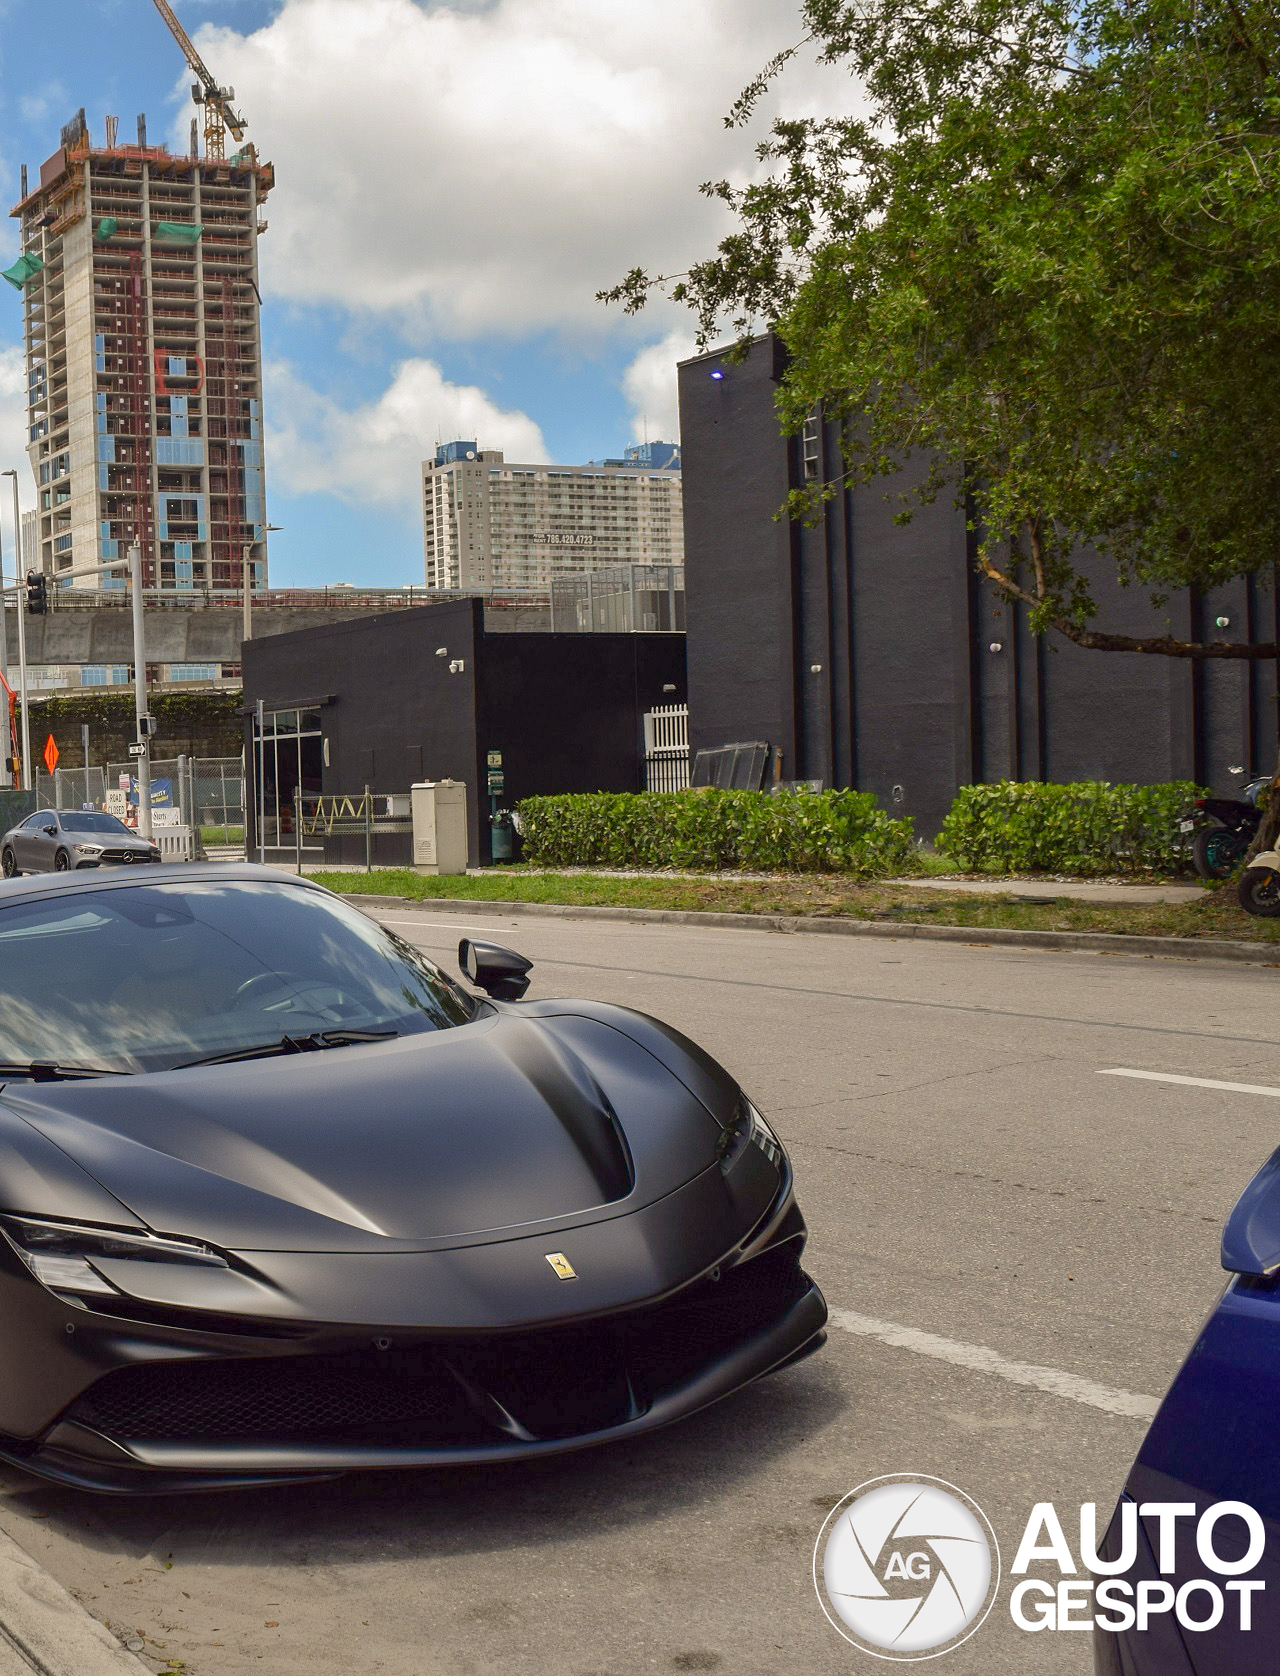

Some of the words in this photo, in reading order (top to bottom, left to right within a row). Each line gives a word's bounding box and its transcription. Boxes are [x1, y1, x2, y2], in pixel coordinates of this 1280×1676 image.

[547, 535, 592, 544] 786.420.4723
[109, 793, 123, 803] ROAD
[108, 805, 125, 815] CLOSED
